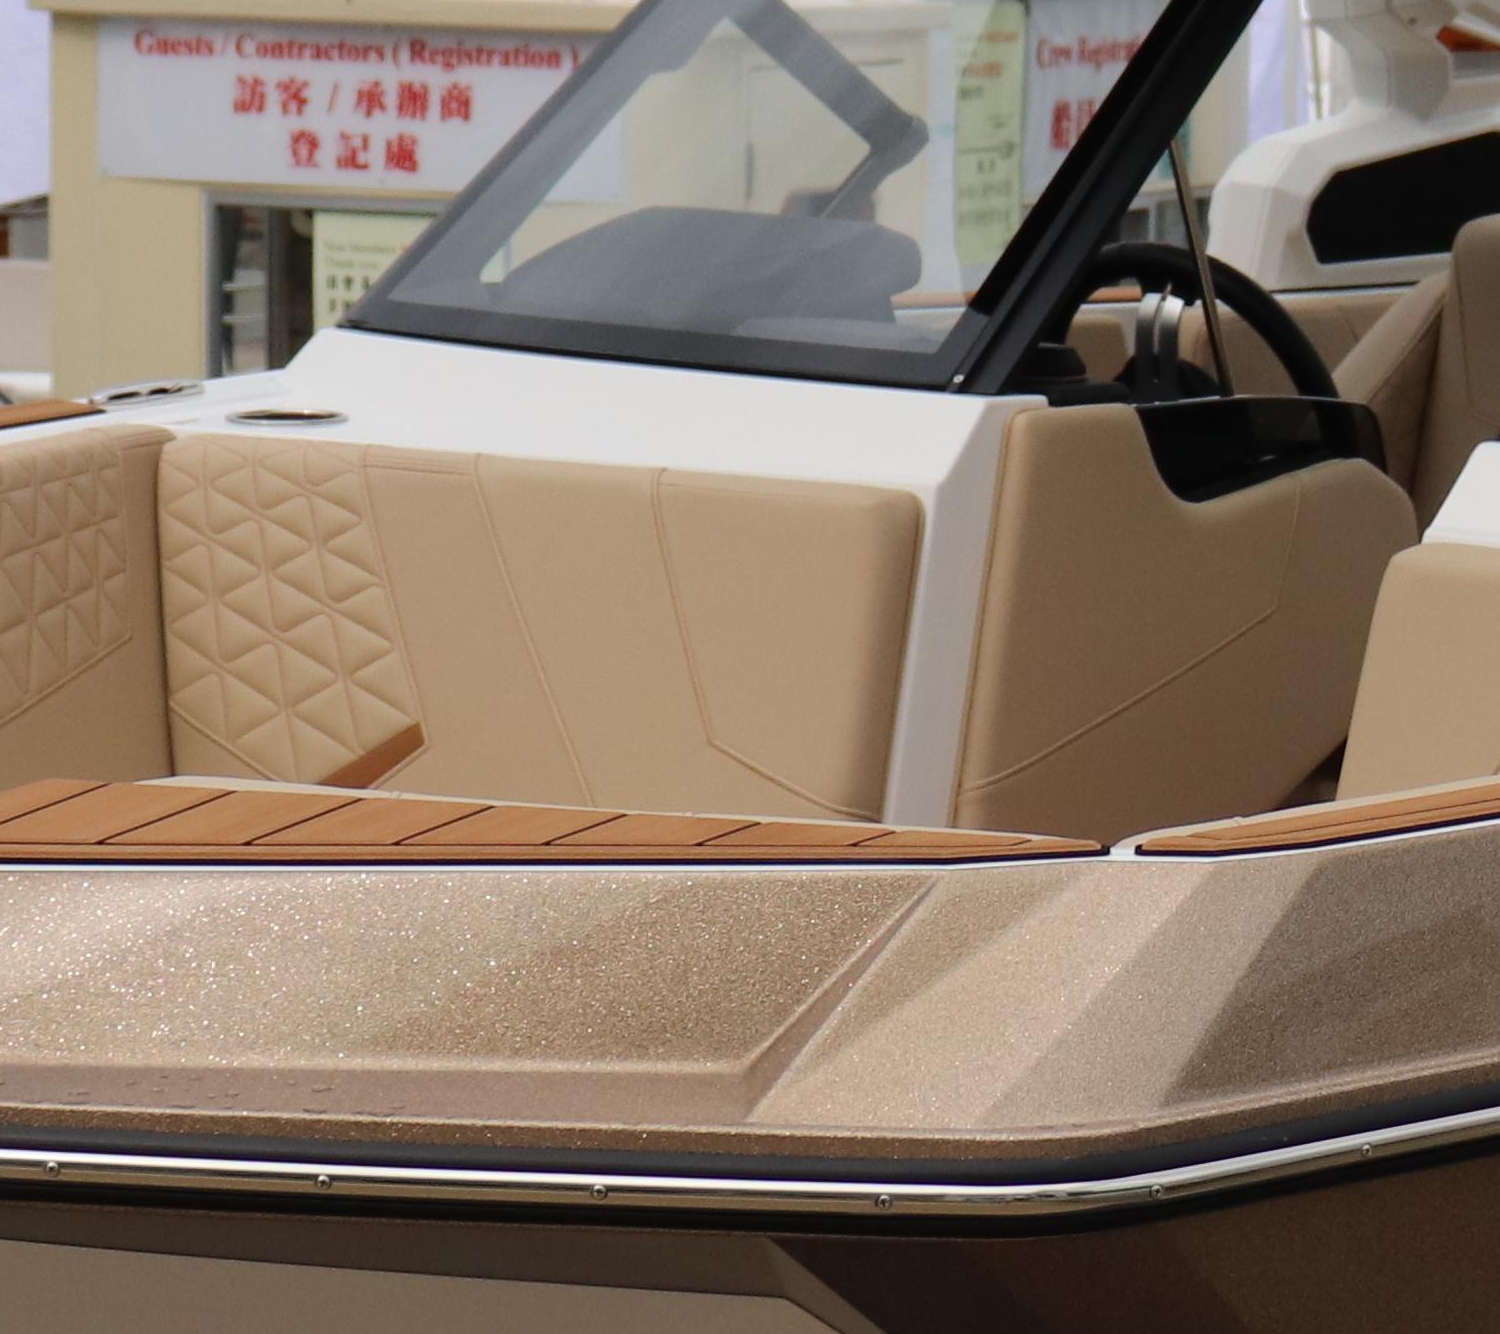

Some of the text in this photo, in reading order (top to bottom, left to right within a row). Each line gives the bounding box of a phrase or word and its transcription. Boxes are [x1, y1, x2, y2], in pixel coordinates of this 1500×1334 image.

[133, 28, 215, 57] Guests
[235, 32, 385, 63] Contractors
[410, 38, 562, 72] Registration
[233, 74, 311, 116] 訪客
